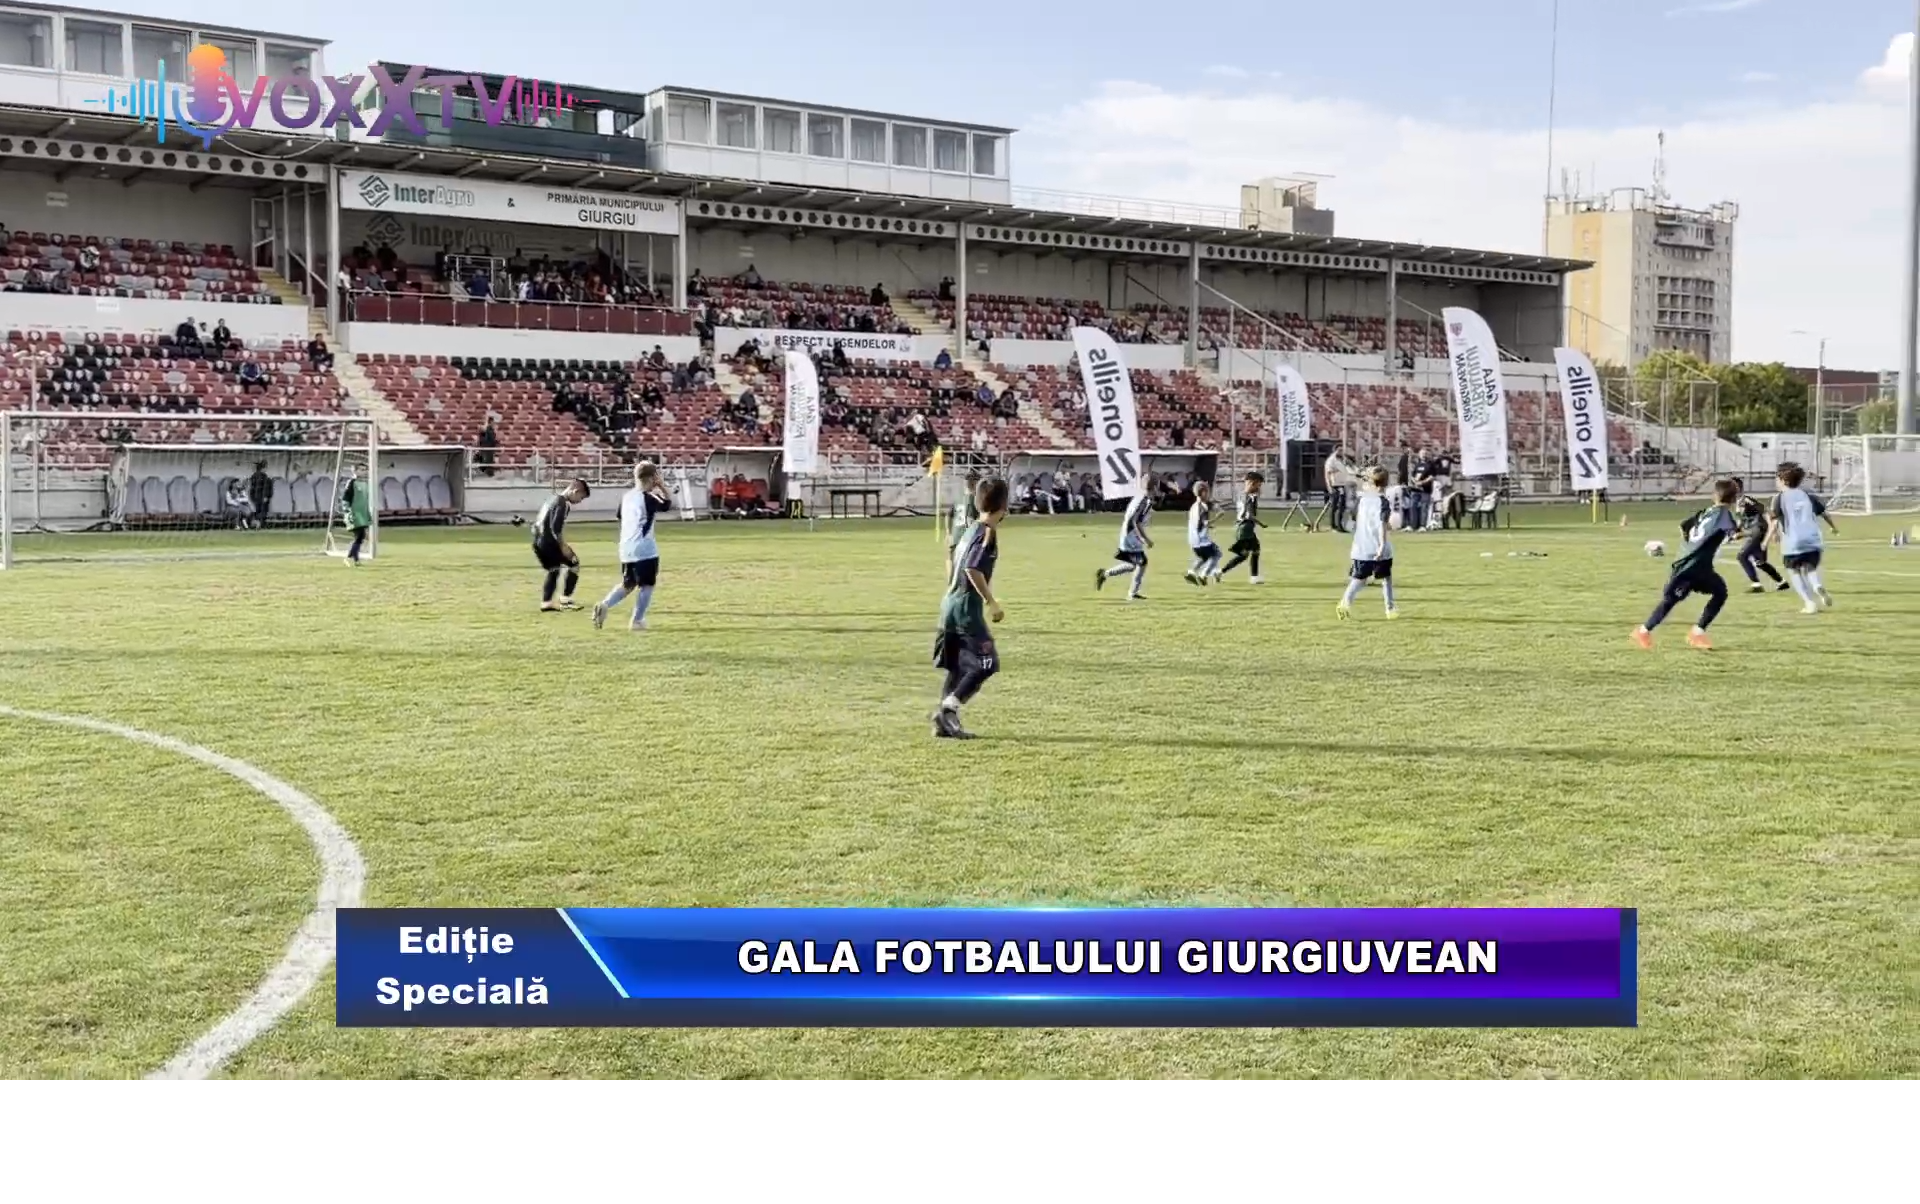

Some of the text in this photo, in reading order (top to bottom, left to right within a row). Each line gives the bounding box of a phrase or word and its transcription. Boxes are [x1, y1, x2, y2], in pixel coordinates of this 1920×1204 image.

[394, 183, 475, 207] InterAgro
[507, 197, 515, 207] &
[599, 197, 664, 212] MUNICIPIULUI
[578, 209, 636, 226] GIURGIU
[774, 335, 823, 347] RESPECT
